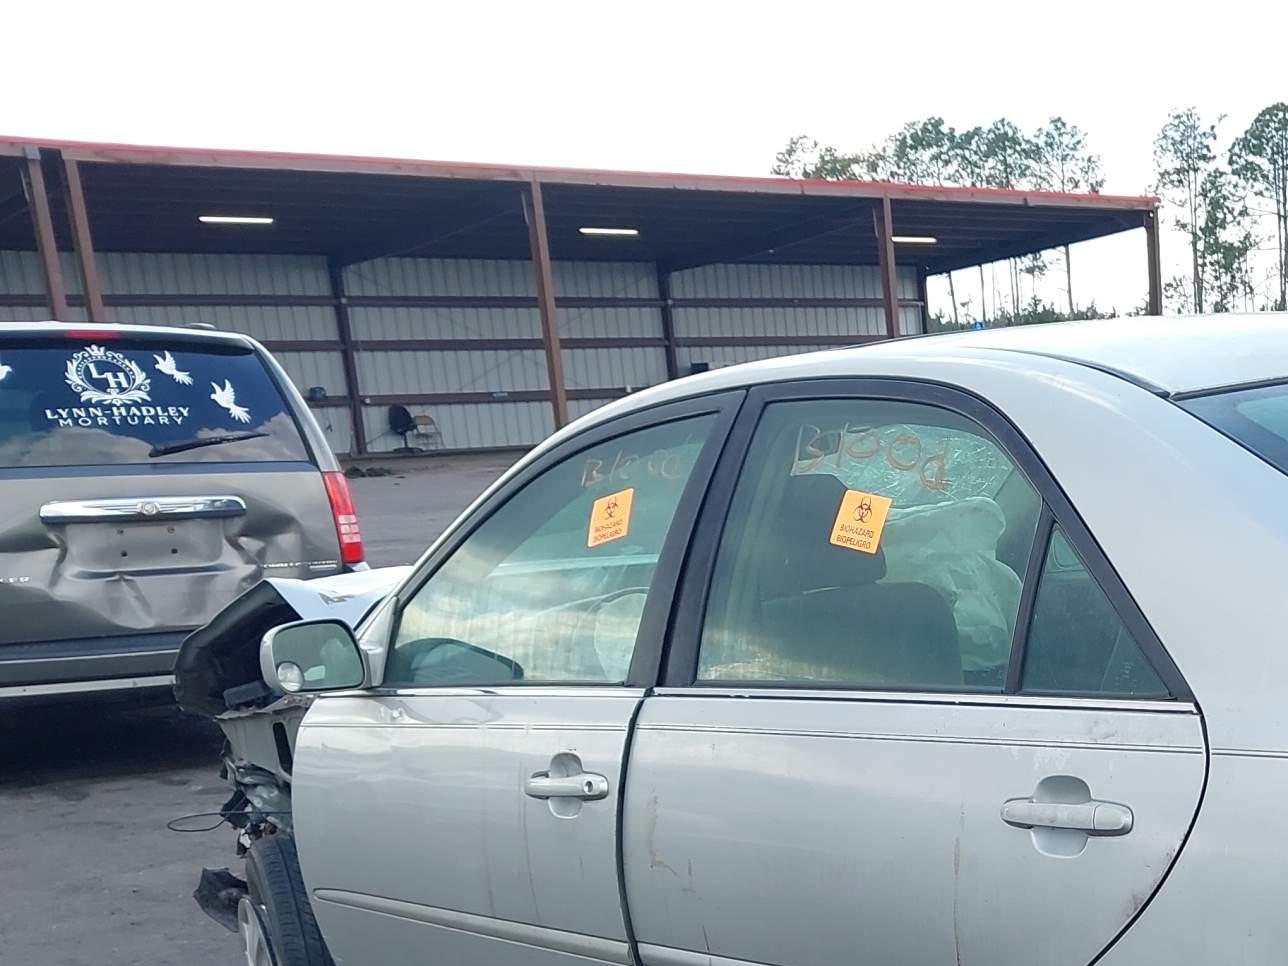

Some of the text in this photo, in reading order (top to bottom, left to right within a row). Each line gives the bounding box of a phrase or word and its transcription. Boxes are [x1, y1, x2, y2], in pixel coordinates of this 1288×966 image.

[87, 362, 129, 388] LH
[45, 406, 190, 419] LYNN-HADLEY
[58, 416, 184, 428] MORTUARY
[839, 523, 875, 539] BIOHAZARD
[836, 534, 872, 550] BIOPELIGRO
